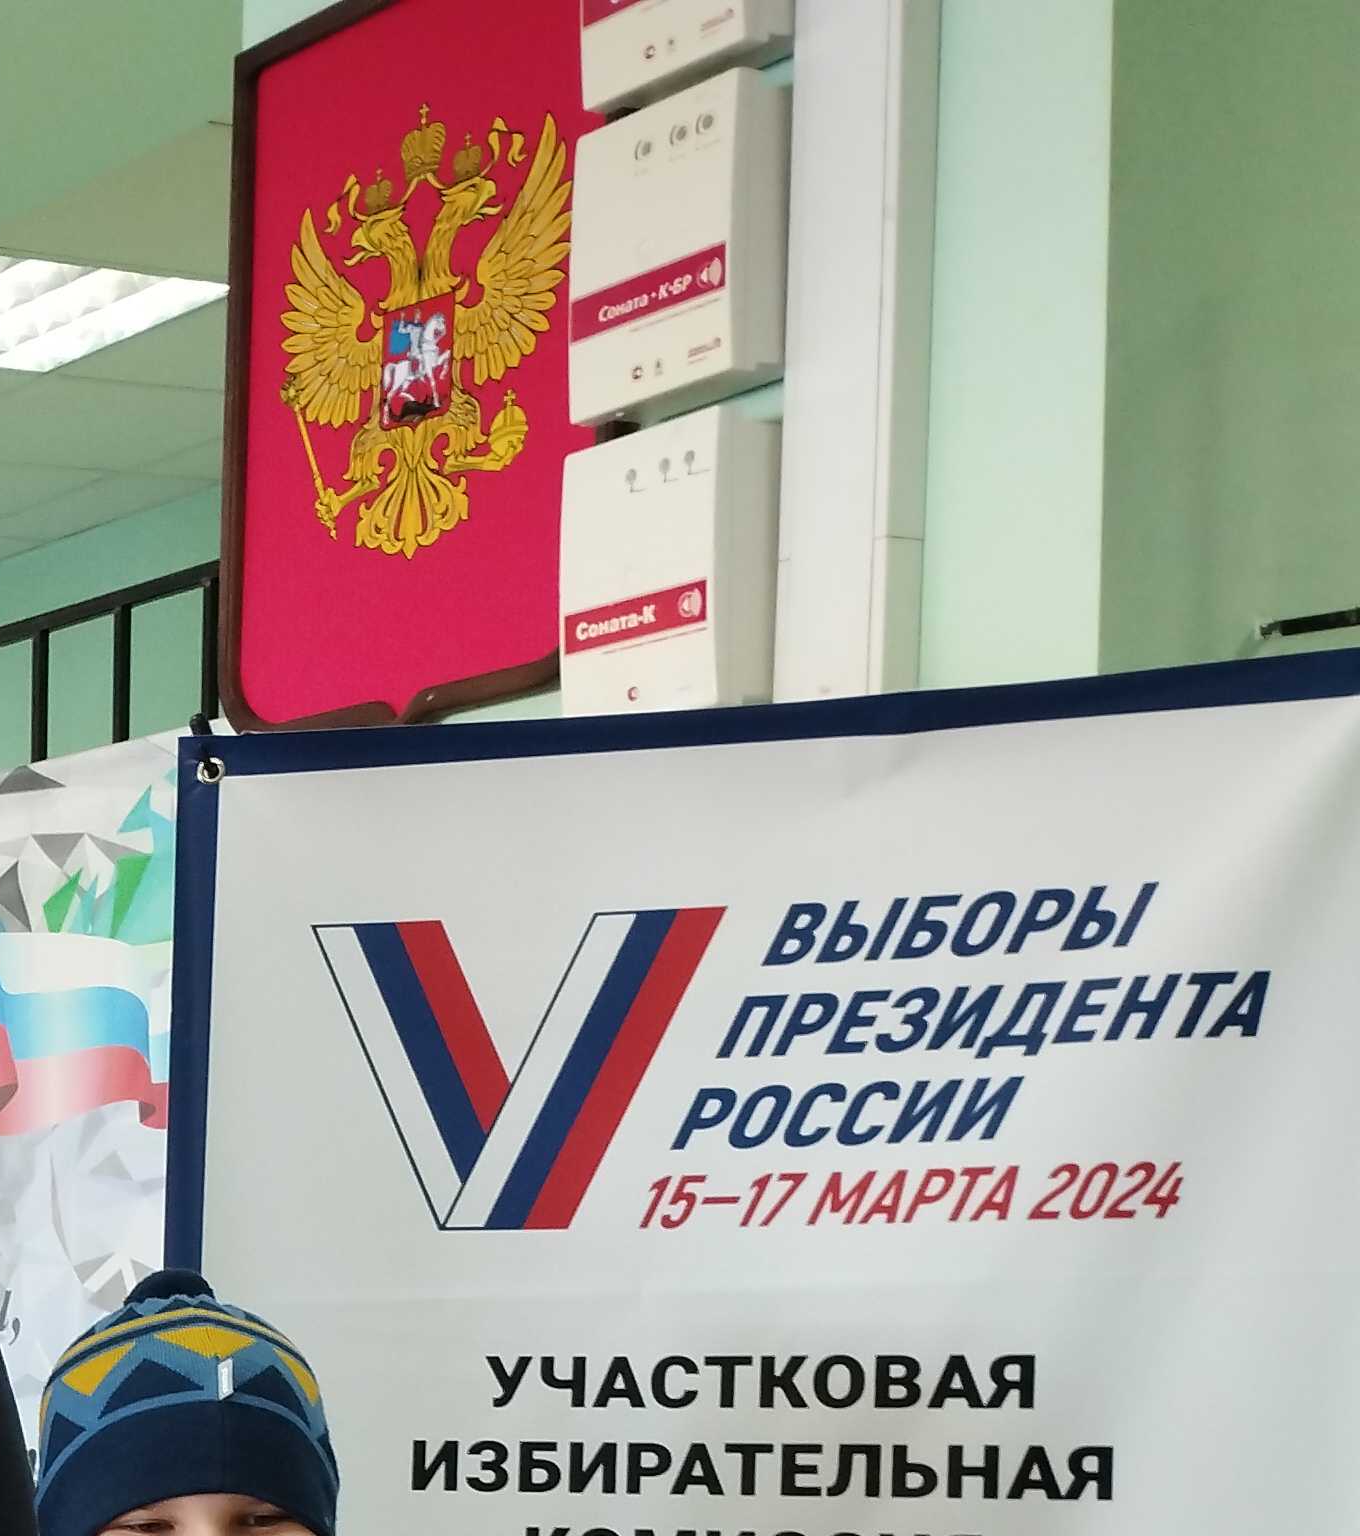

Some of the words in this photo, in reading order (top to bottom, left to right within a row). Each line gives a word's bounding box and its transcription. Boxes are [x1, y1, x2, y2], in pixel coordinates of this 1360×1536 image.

[575, 602, 657, 641] Соната-К
[762, 882, 1159, 966] ВЫБОРЫ
[716, 971, 1271, 1059] ПРЕЗИДЕНТА
[670, 1076, 1024, 1150] РОССИИ
[808, 1166, 1019, 1225] МАРТА
[1028, 1162, 1183, 1219] 2024
[486, 1355, 1035, 1409] УЧАСТКОВАЯ
[412, 1440, 1113, 1500] ИЗБИРАТЕЛЬНАЯ
